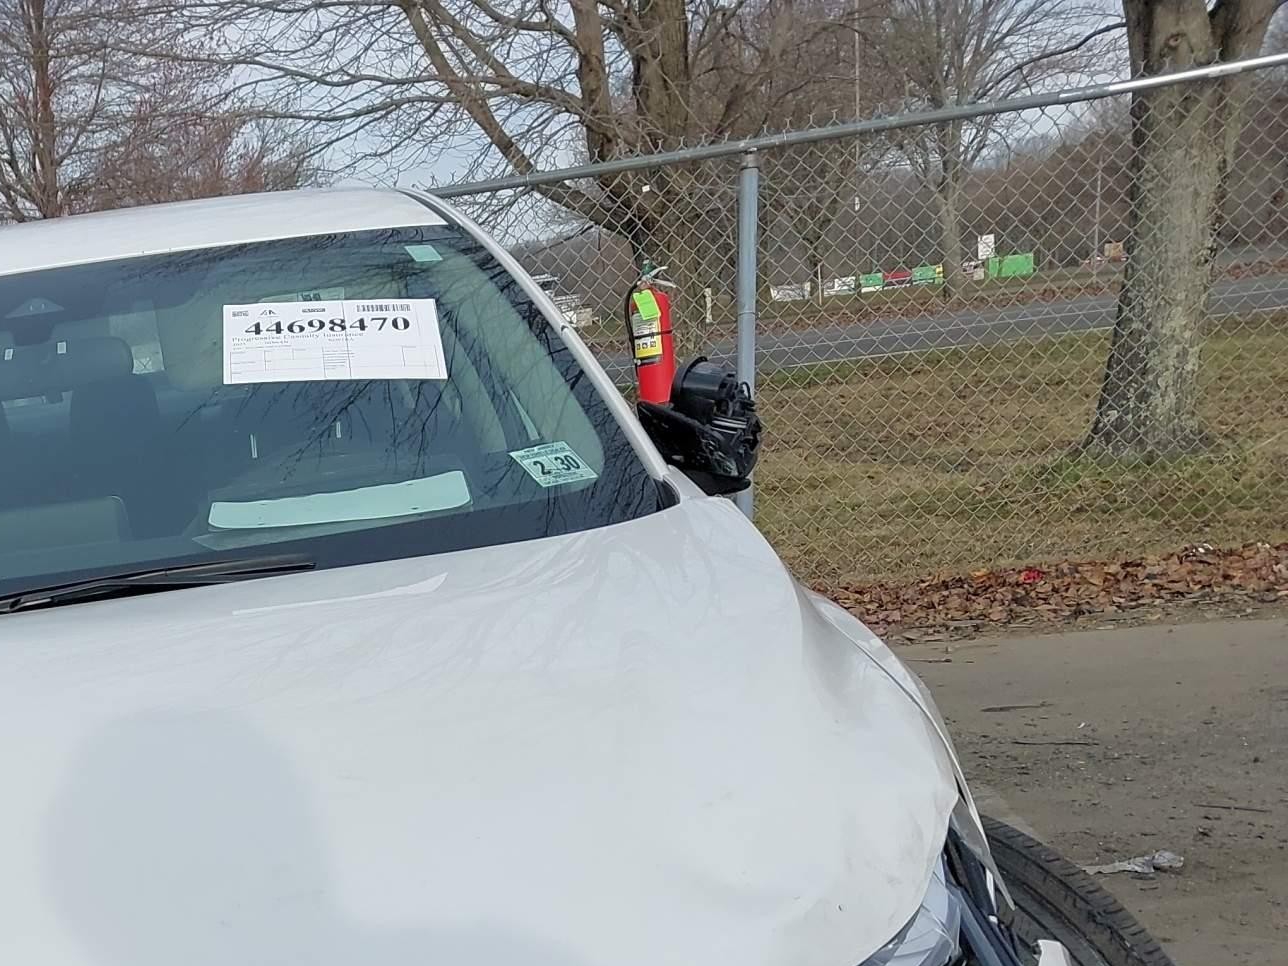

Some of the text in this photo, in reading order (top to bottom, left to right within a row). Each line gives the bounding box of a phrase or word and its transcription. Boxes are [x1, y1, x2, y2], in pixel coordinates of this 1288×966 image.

[244, 317, 411, 335] 44698470
[533, 454, 581, 476] 2 30
